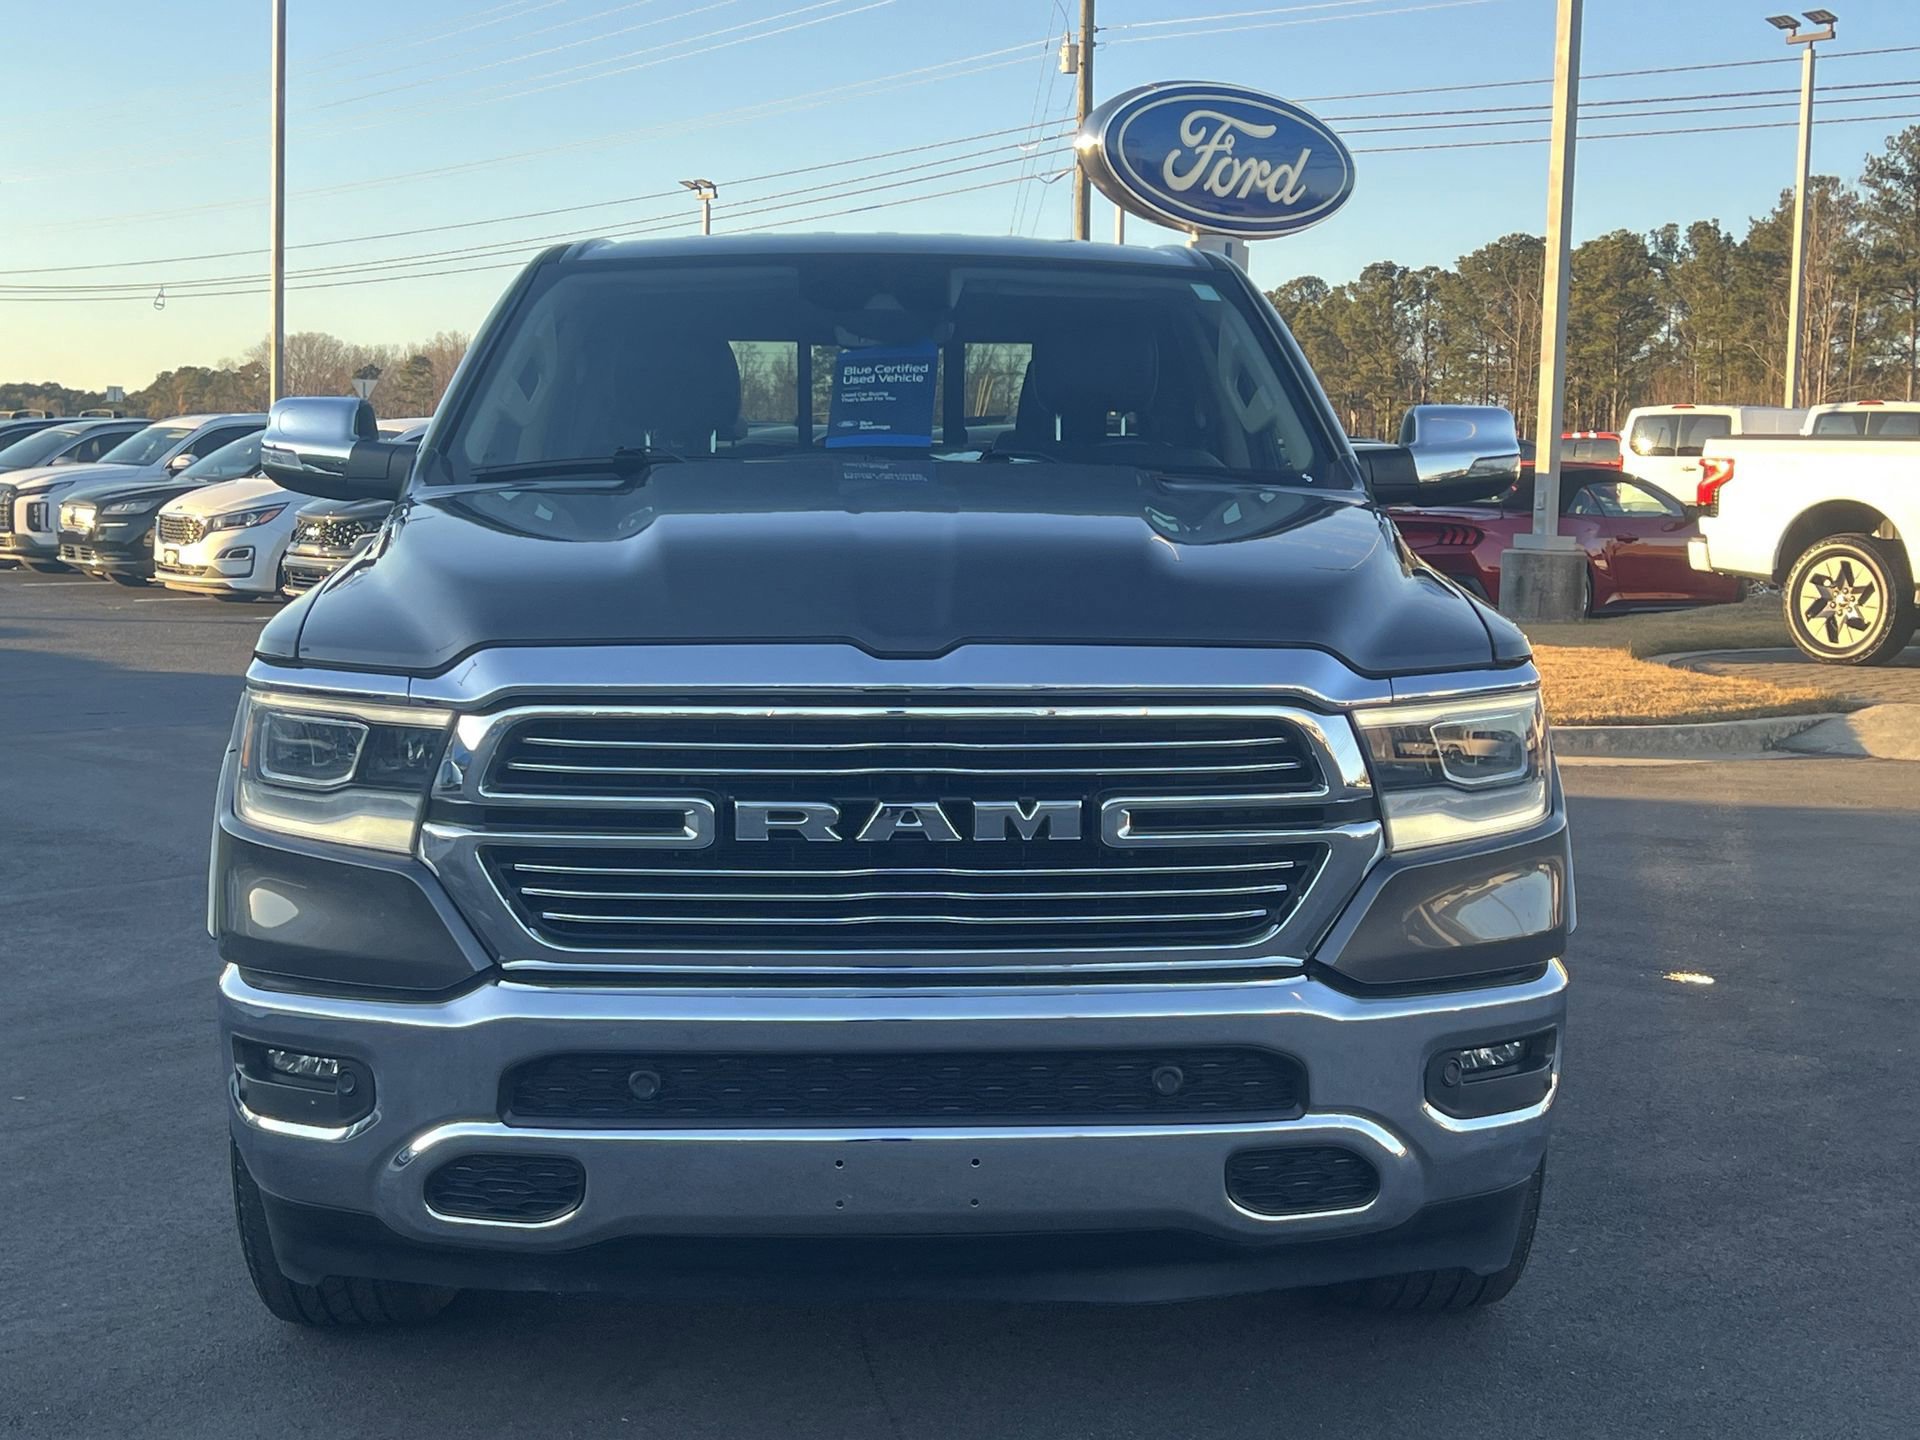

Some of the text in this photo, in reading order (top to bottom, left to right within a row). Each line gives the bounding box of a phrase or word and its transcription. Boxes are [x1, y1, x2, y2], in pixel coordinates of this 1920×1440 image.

[1163, 109, 1312, 205] Ford
[843, 373, 924, 385] Used Vehicle
[844, 363, 929, 375] Blue Certified
[734, 799, 1084, 842] RAM
